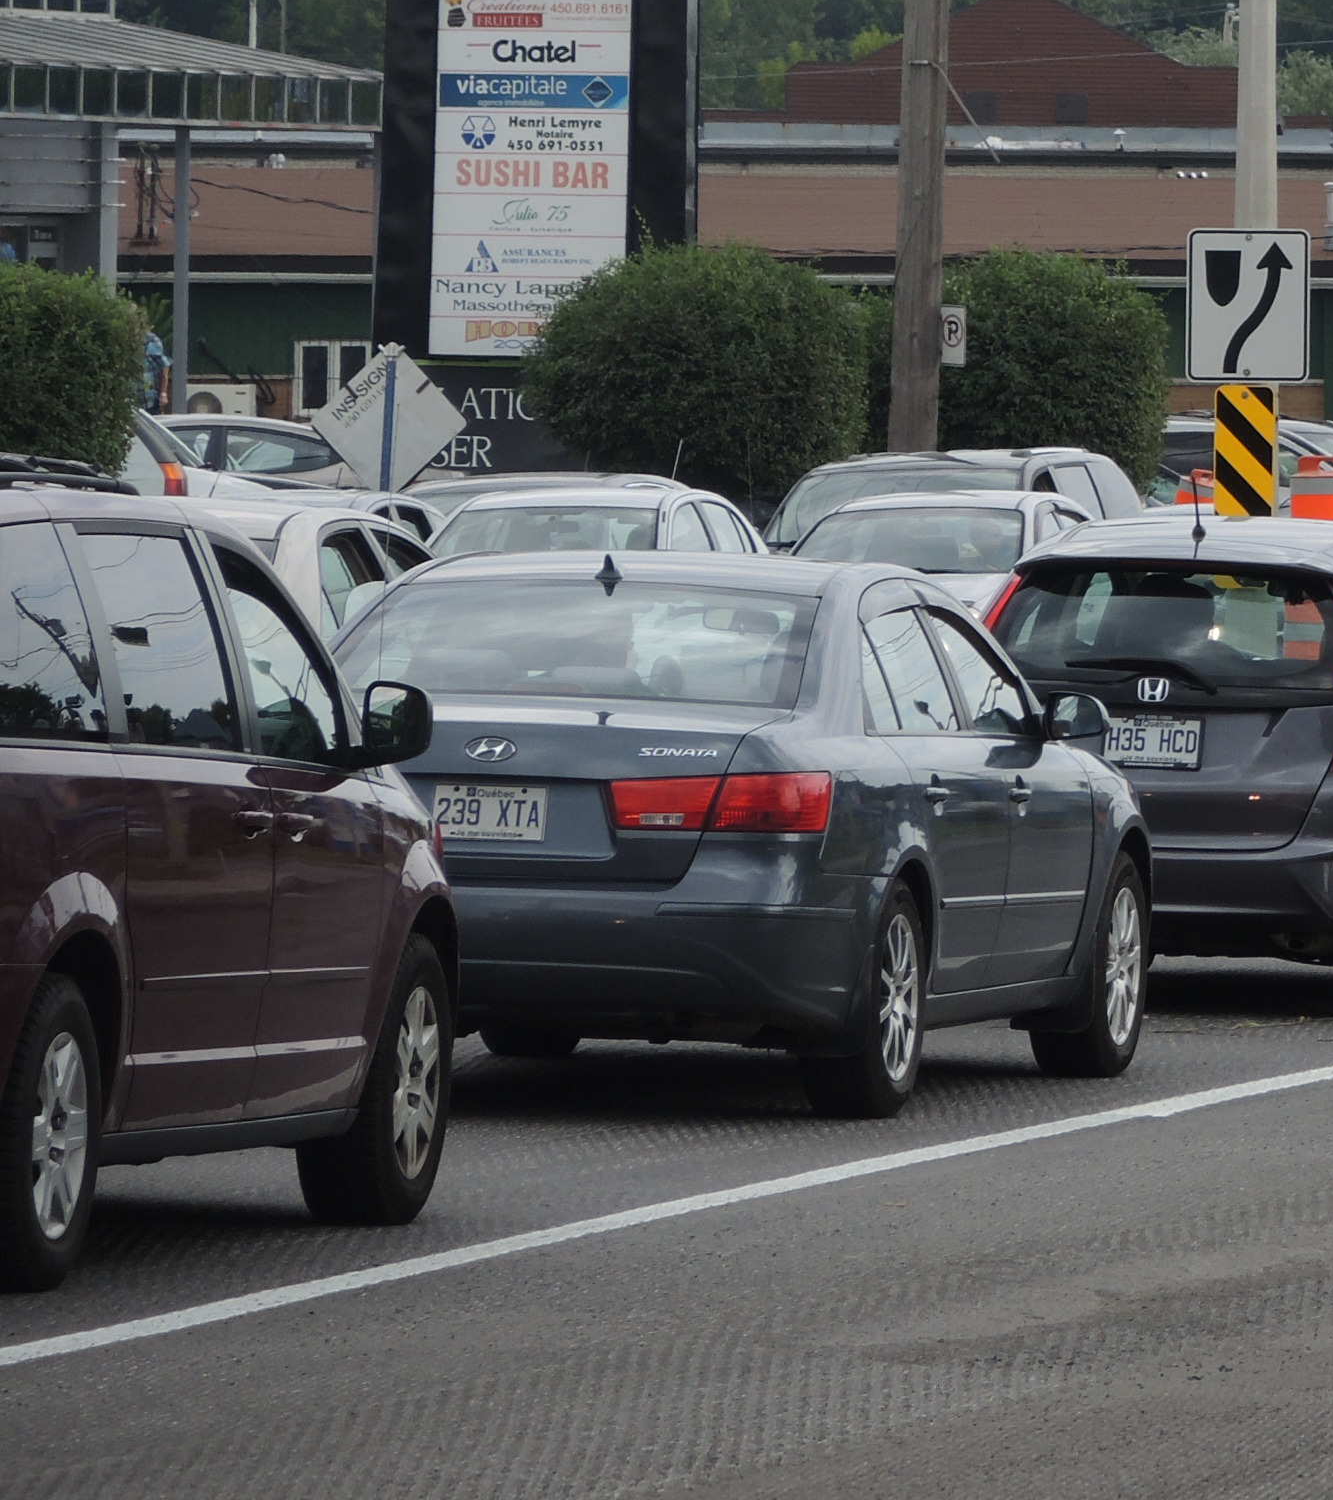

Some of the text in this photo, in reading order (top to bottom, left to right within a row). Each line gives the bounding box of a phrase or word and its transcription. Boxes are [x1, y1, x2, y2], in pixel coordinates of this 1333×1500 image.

[476, 14, 540, 27] FRUITÉES
[492, 39, 576, 63] Chatel
[508, 116, 603, 131] Henri Lemyre
[536, 129, 574, 139] Notaire
[507, 140, 604, 152] 450 691-0551
[456, 158, 610, 190] SUSHI BAR
[502, 248, 567, 257] ASSURANCES
[435, 278, 507, 299] Nancy
[1107, 727, 1198, 753] H35 HCD
[638, 746, 718, 758] SONATA
[436, 797, 539, 828] 239 XTA
